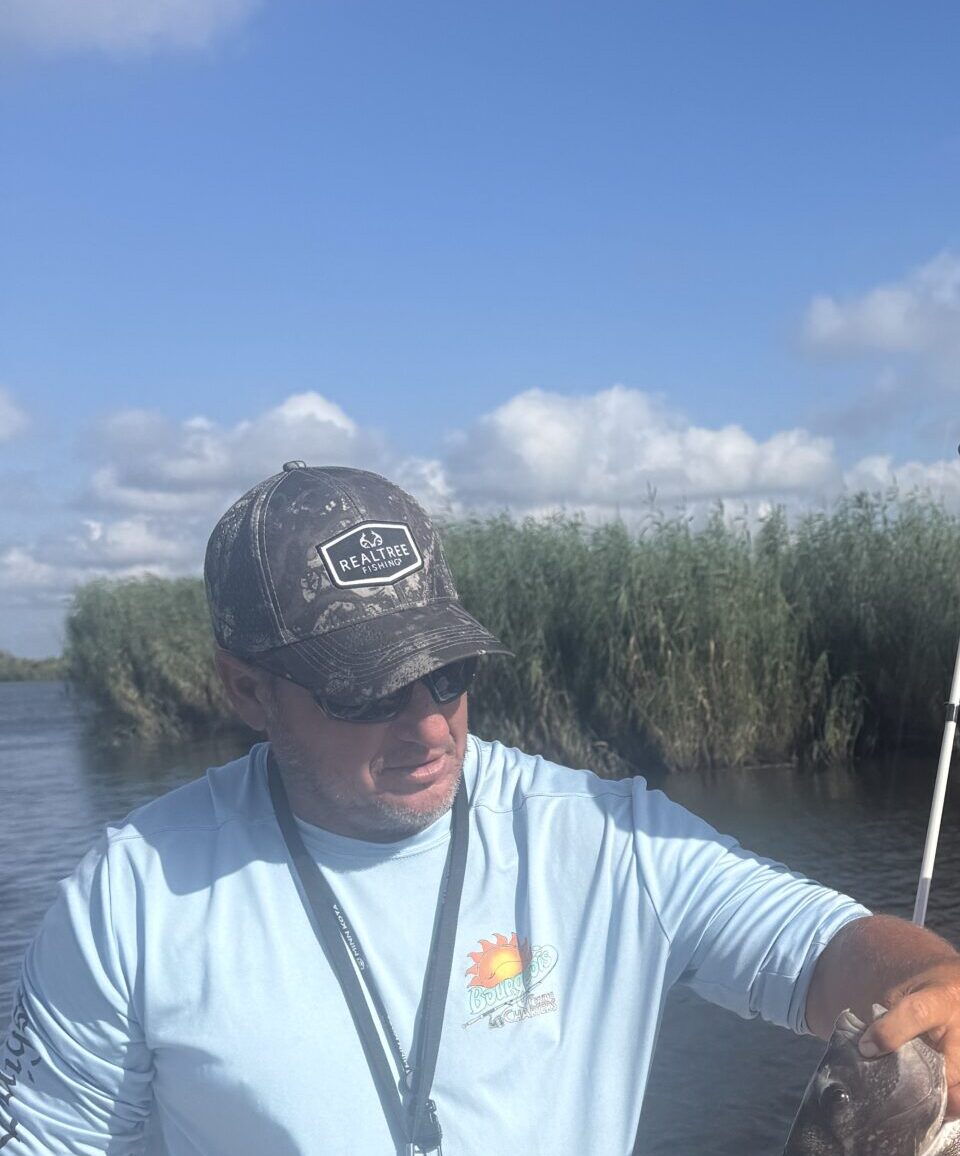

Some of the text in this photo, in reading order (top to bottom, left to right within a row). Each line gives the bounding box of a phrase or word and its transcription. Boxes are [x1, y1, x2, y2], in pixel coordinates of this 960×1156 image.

[339, 543, 410, 572] REALTREE
[361, 558, 402, 574] FISHING
[344, 930, 359, 957] MINN
